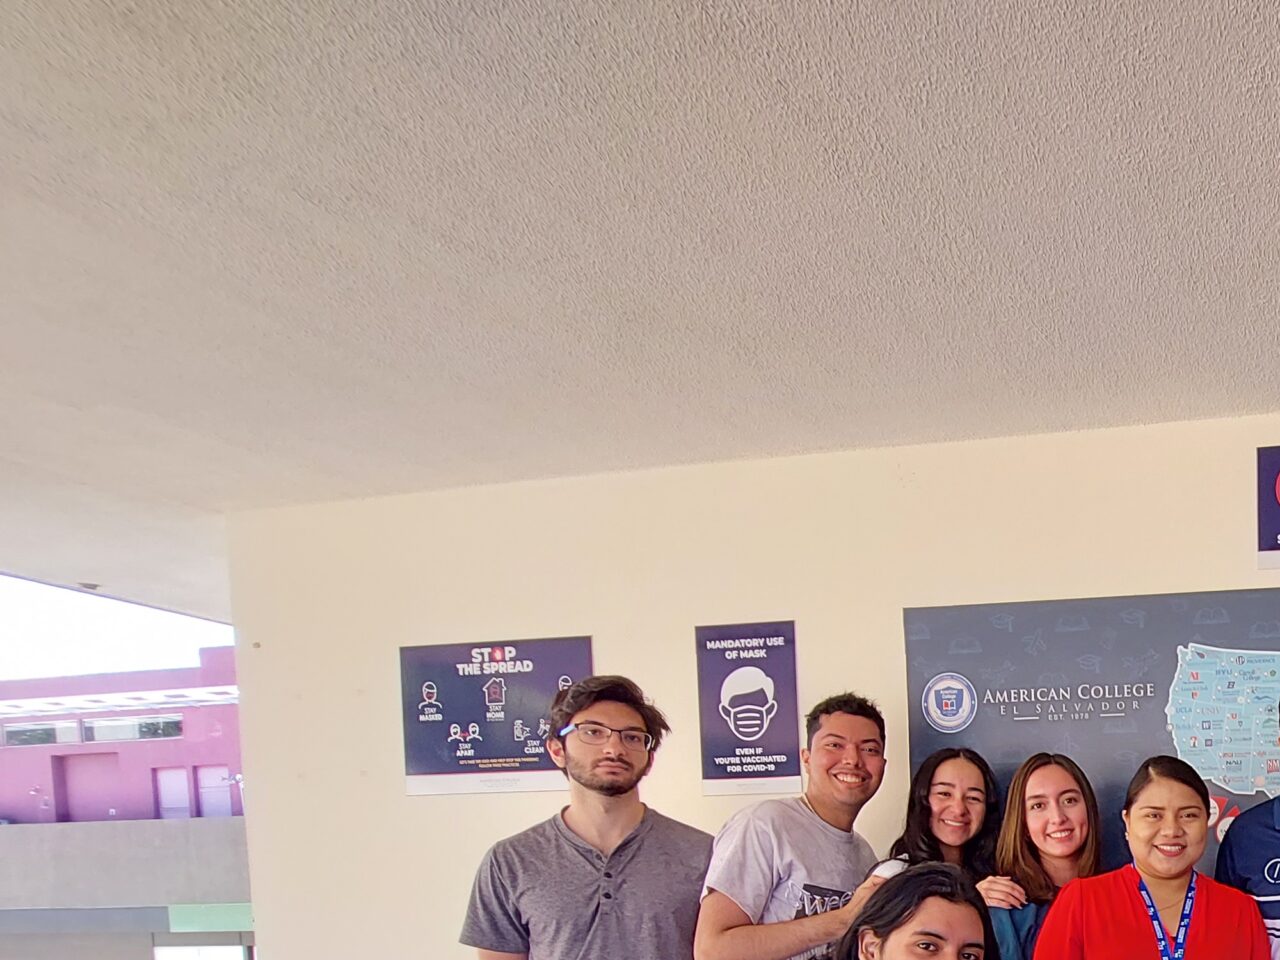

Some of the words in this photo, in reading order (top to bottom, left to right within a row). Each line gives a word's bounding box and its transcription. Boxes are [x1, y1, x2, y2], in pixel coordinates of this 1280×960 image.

[706, 638, 764, 650] MANDATORY
[766, 637, 784, 646] USE
[725, 650, 738, 660] OF
[740, 649, 767, 659] MASK
[456, 663, 481, 676] THE
[483, 660, 533, 675] SPREAD
[983, 687, 1071, 704] AMERICAN
[1077, 683, 1155, 699] COLLEGE
[1000, 705, 1019, 715] EL
[1036, 700, 1140, 714] SALVADOR
[524, 746, 545, 754] CLEAN
[735, 748, 754, 756] EVEN
[756, 747, 763, 755] IF
[714, 757, 740, 765] YOU'RE
[741, 755, 787, 764] VACCINATED
[743, 764, 775, 772] COVID-19
